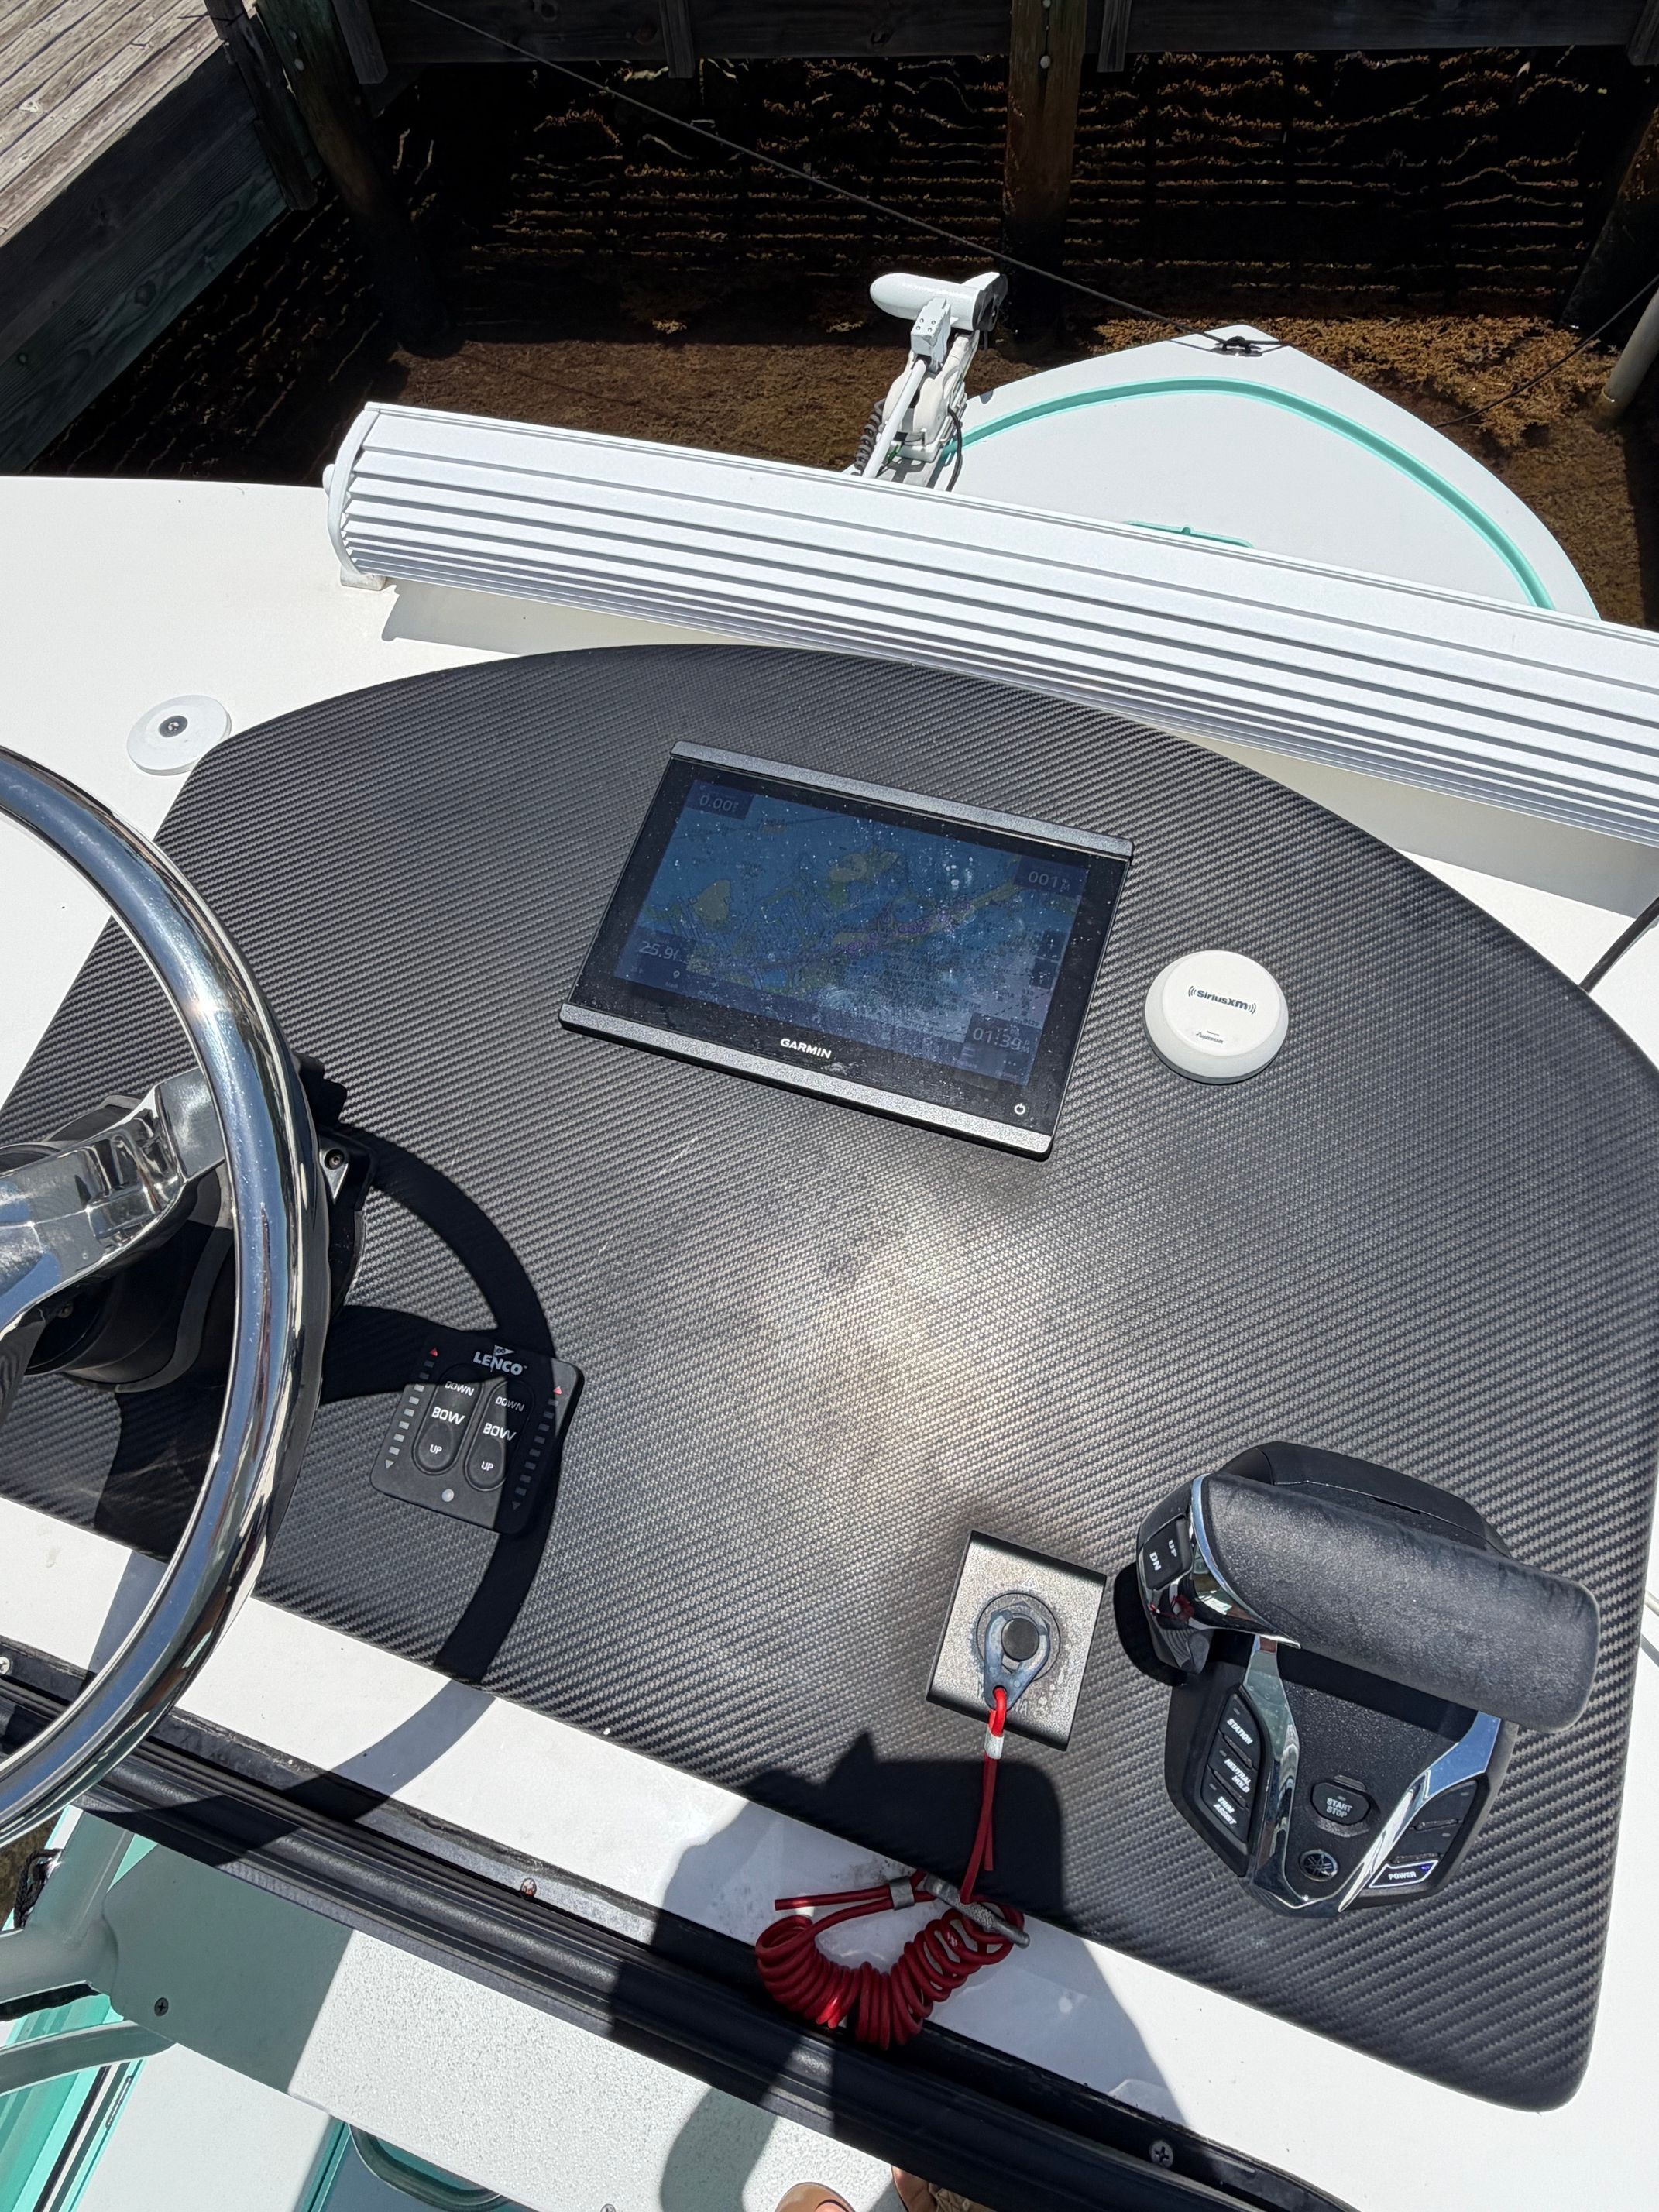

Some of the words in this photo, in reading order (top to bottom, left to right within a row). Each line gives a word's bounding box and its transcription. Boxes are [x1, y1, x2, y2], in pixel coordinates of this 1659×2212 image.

[699, 792, 733, 812] 0.00
[1028, 871, 1059, 888] 001
[973, 1027, 1022, 1050] 01:39
[780, 1038, 832, 1059] GARMIN
[472, 1351, 524, 1376] LENCO
[445, 1380, 475, 1396] DOWN
[495, 1396, 525, 1412] DOWN
[431, 1407, 465, 1425] BOW
[483, 1422, 517, 1441] BOW
[429, 1444, 443, 1455] UP
[481, 1461, 494, 1472] UP
[1168, 1539, 1177, 1557] UP
[1149, 1551, 1162, 1571] DN
[1226, 1718, 1253, 1745] STATION
[1224, 1758, 1252, 1787] NEUTRAL
[1231, 1774, 1250, 1793] HOLD
[1218, 1795, 1235, 1814] TRIM
[1326, 1797, 1353, 1812] START
[1326, 1805, 1348, 1819] STOP
[1213, 1803, 1238, 1826] ASSIST
[1388, 1870, 1417, 1881] POWER
